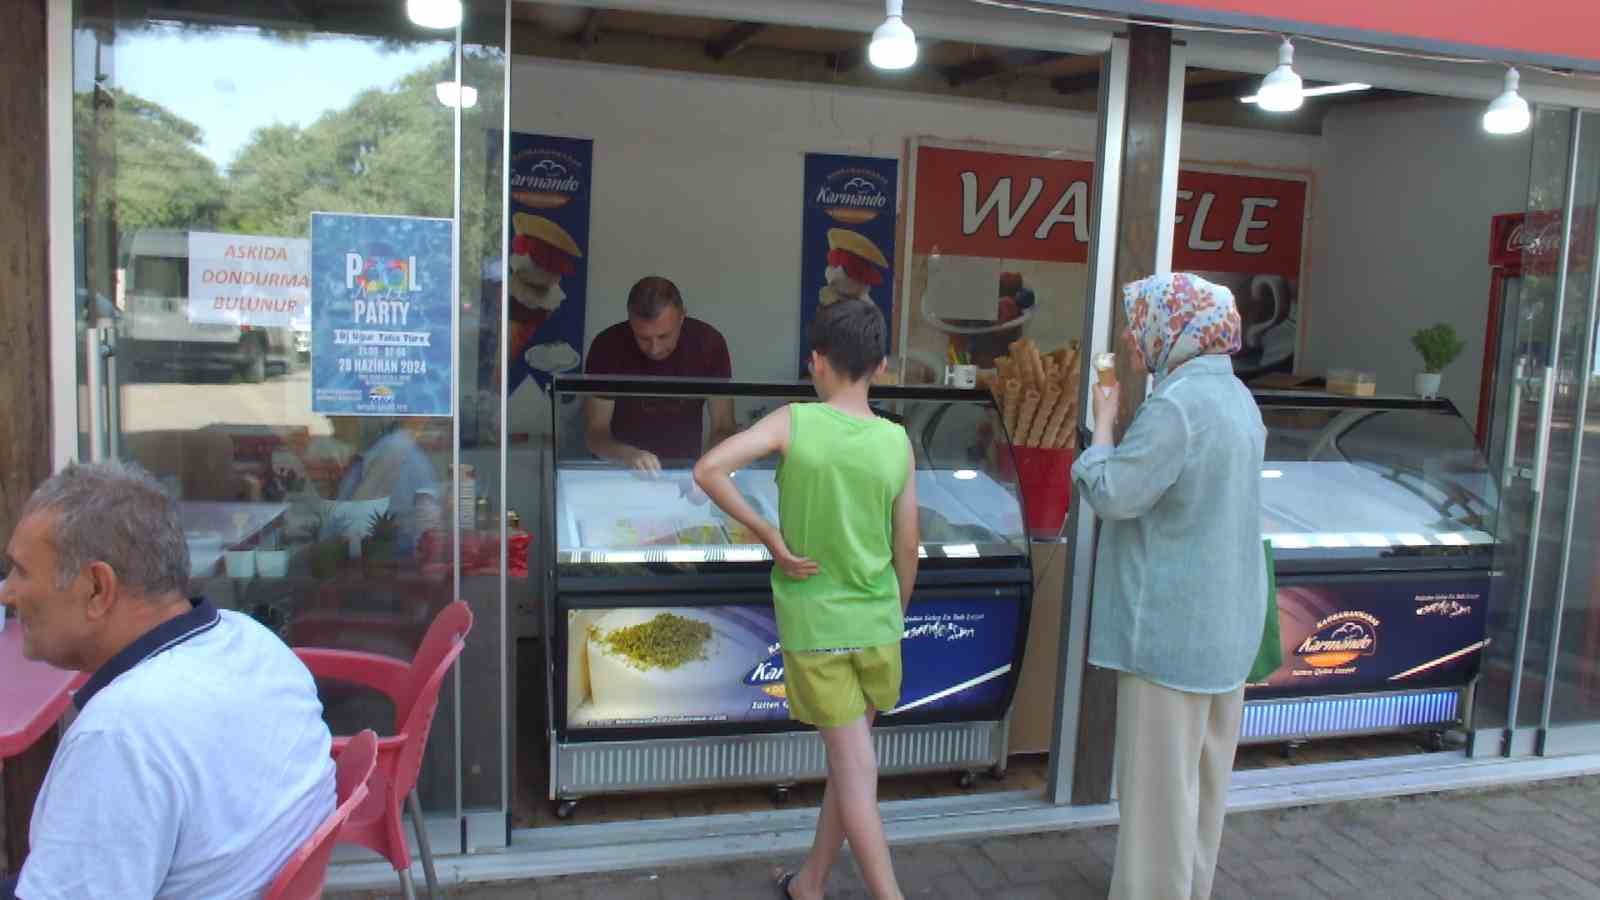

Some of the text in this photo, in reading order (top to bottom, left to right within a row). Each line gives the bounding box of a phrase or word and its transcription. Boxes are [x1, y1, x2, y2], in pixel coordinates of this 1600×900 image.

[224, 244, 289, 261] ASKIDA
[200, 270, 310, 288] DONDURMA
[345, 252, 423, 292] POOL
[214, 296, 298, 312] BULUNUR
[353, 299, 410, 325] PARTY
[400, 358, 428, 375] 2024
